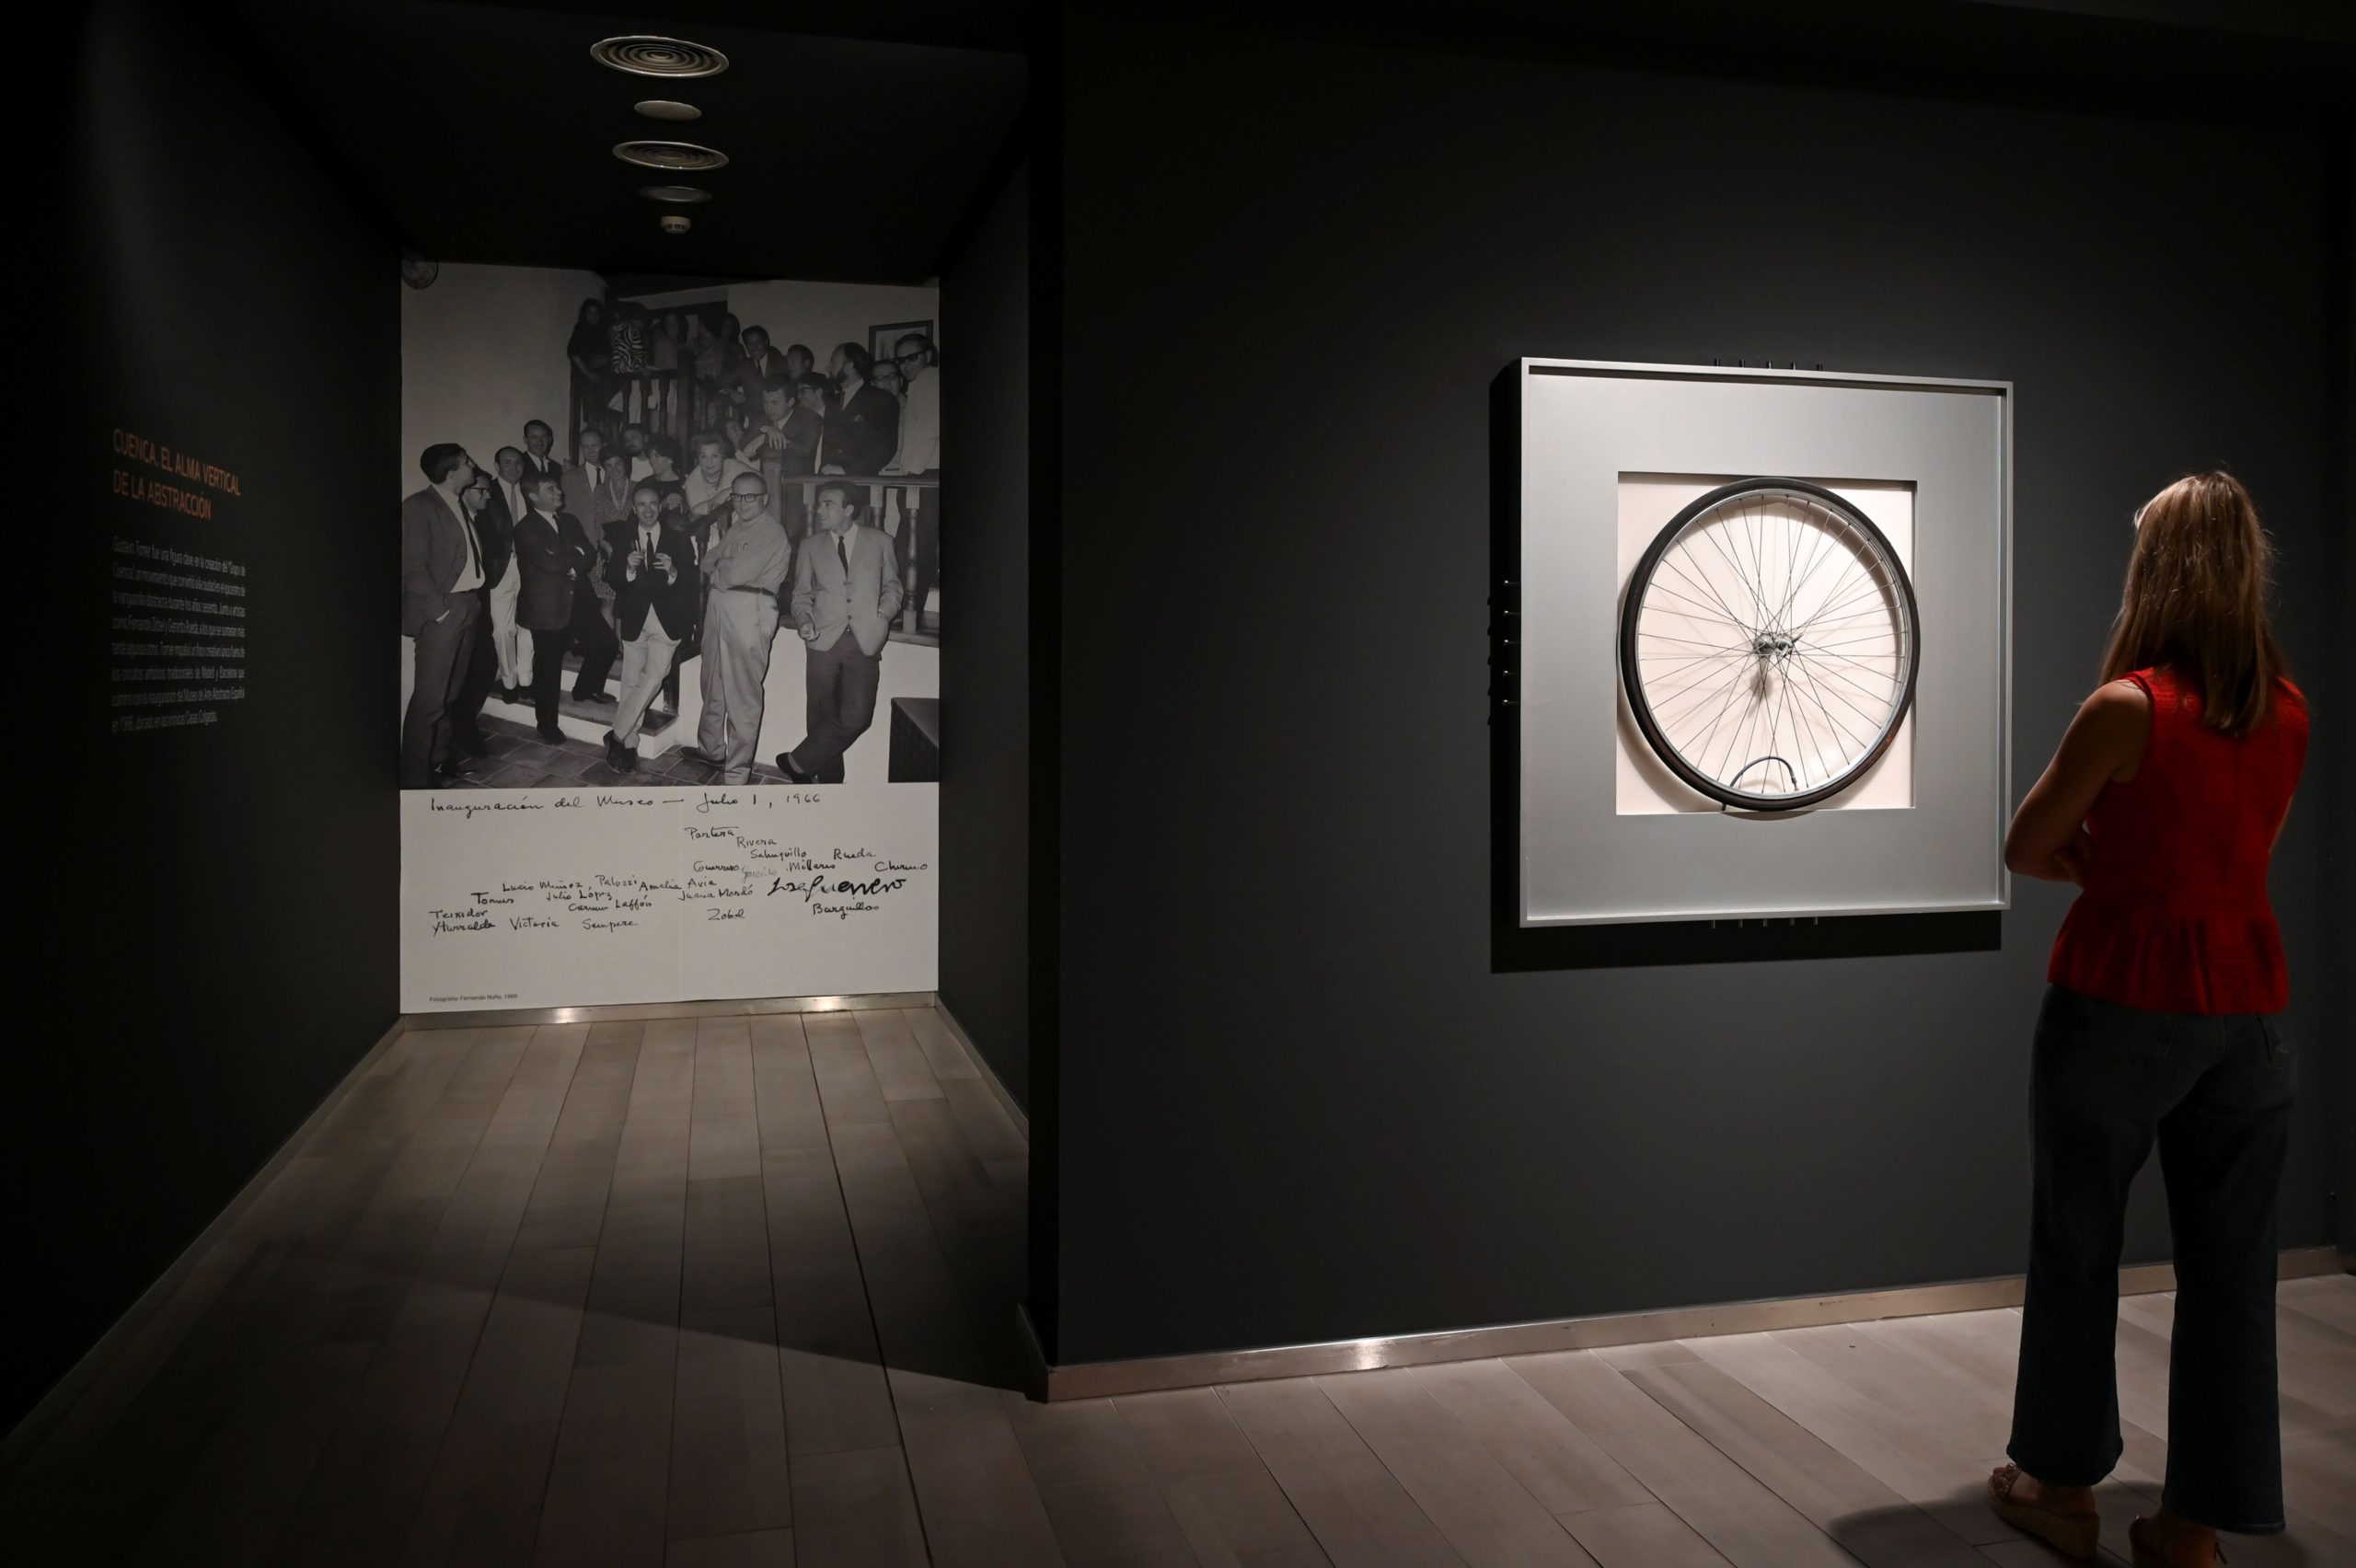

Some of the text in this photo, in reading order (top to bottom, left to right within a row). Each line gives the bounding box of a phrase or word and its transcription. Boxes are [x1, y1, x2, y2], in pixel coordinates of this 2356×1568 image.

[113, 428, 242, 497] CUENCA. EL ALMA VERTICAL
[113, 469, 213, 521] DE LA ABSTRACCIÓN
[431, 795, 545, 819] Inauguración
[554, 796, 584, 808] del
[596, 795, 654, 807] Museo
[786, 793, 821, 804] 1966
[736, 836, 778, 848] Rivera
[502, 881, 534, 892] Lucio
[546, 886, 612, 901] Julio López
